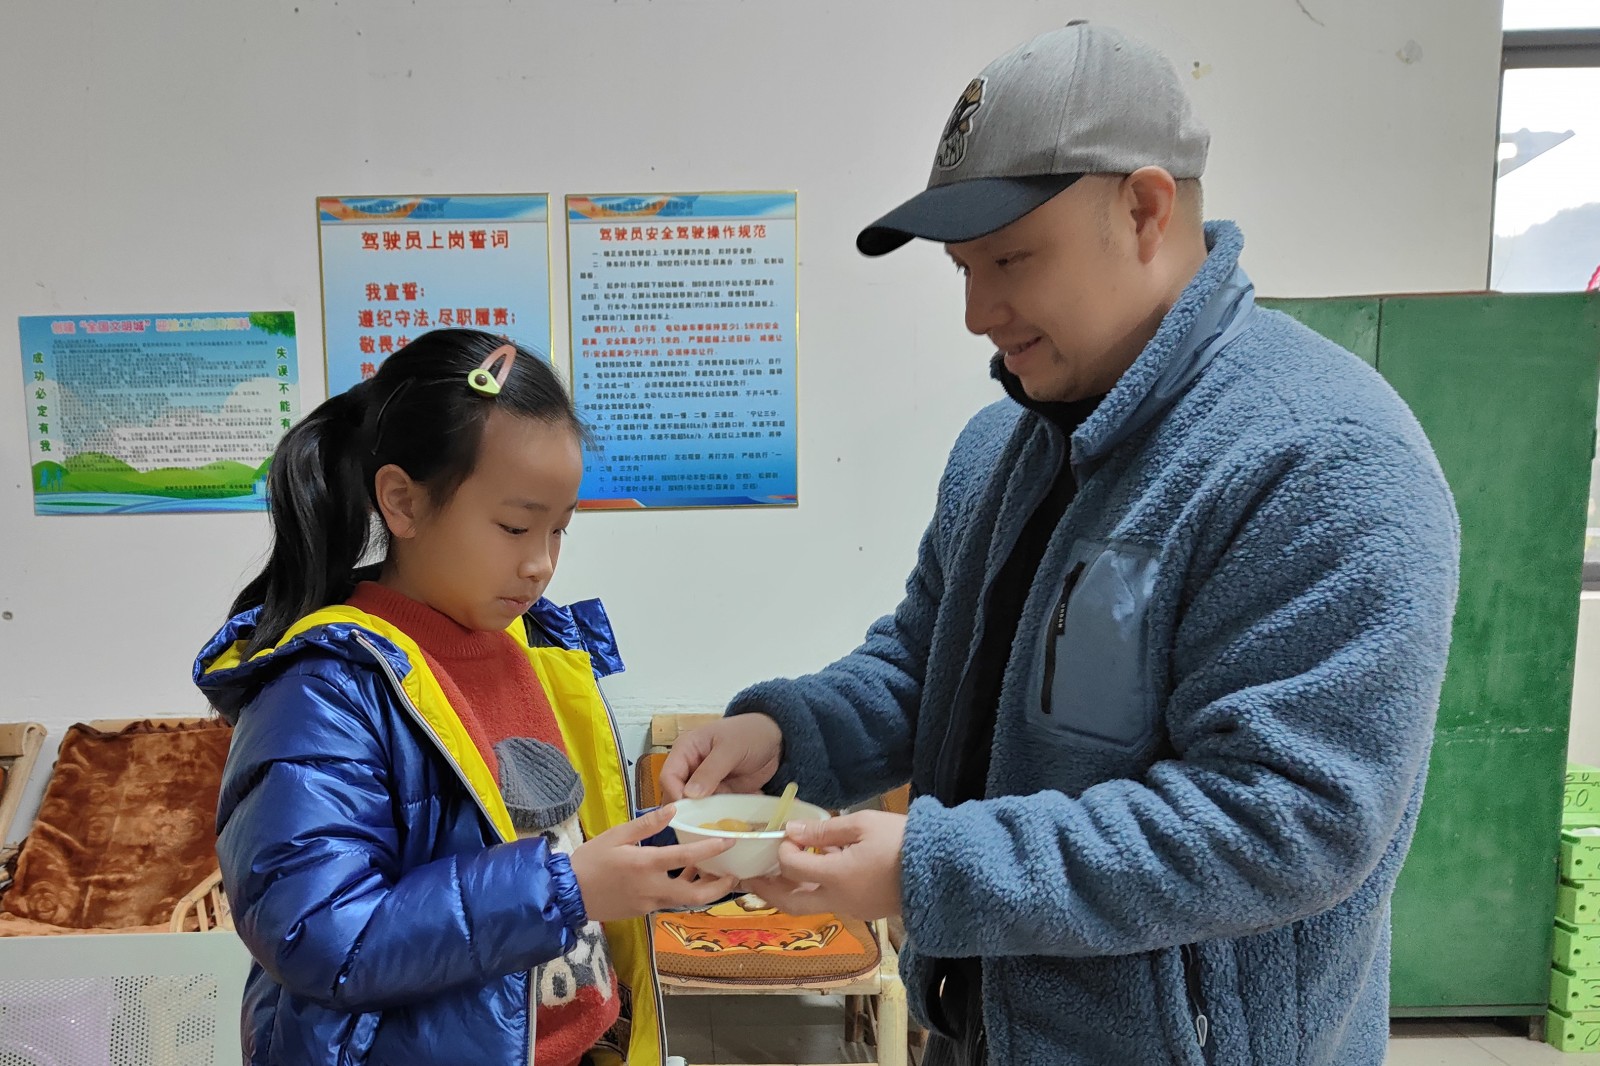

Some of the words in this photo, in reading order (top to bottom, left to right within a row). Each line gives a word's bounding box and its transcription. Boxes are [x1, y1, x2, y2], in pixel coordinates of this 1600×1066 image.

[361, 229, 510, 250] 驾驶员上岗誓词
[599, 224, 767, 242] 驾驶员安全驾驶操作规范
[365, 282, 425, 301] 我宣誓：
[358, 308, 516, 328] 遵纪守法，尽职履责；
[32, 352, 52, 453] 成功必定有我
